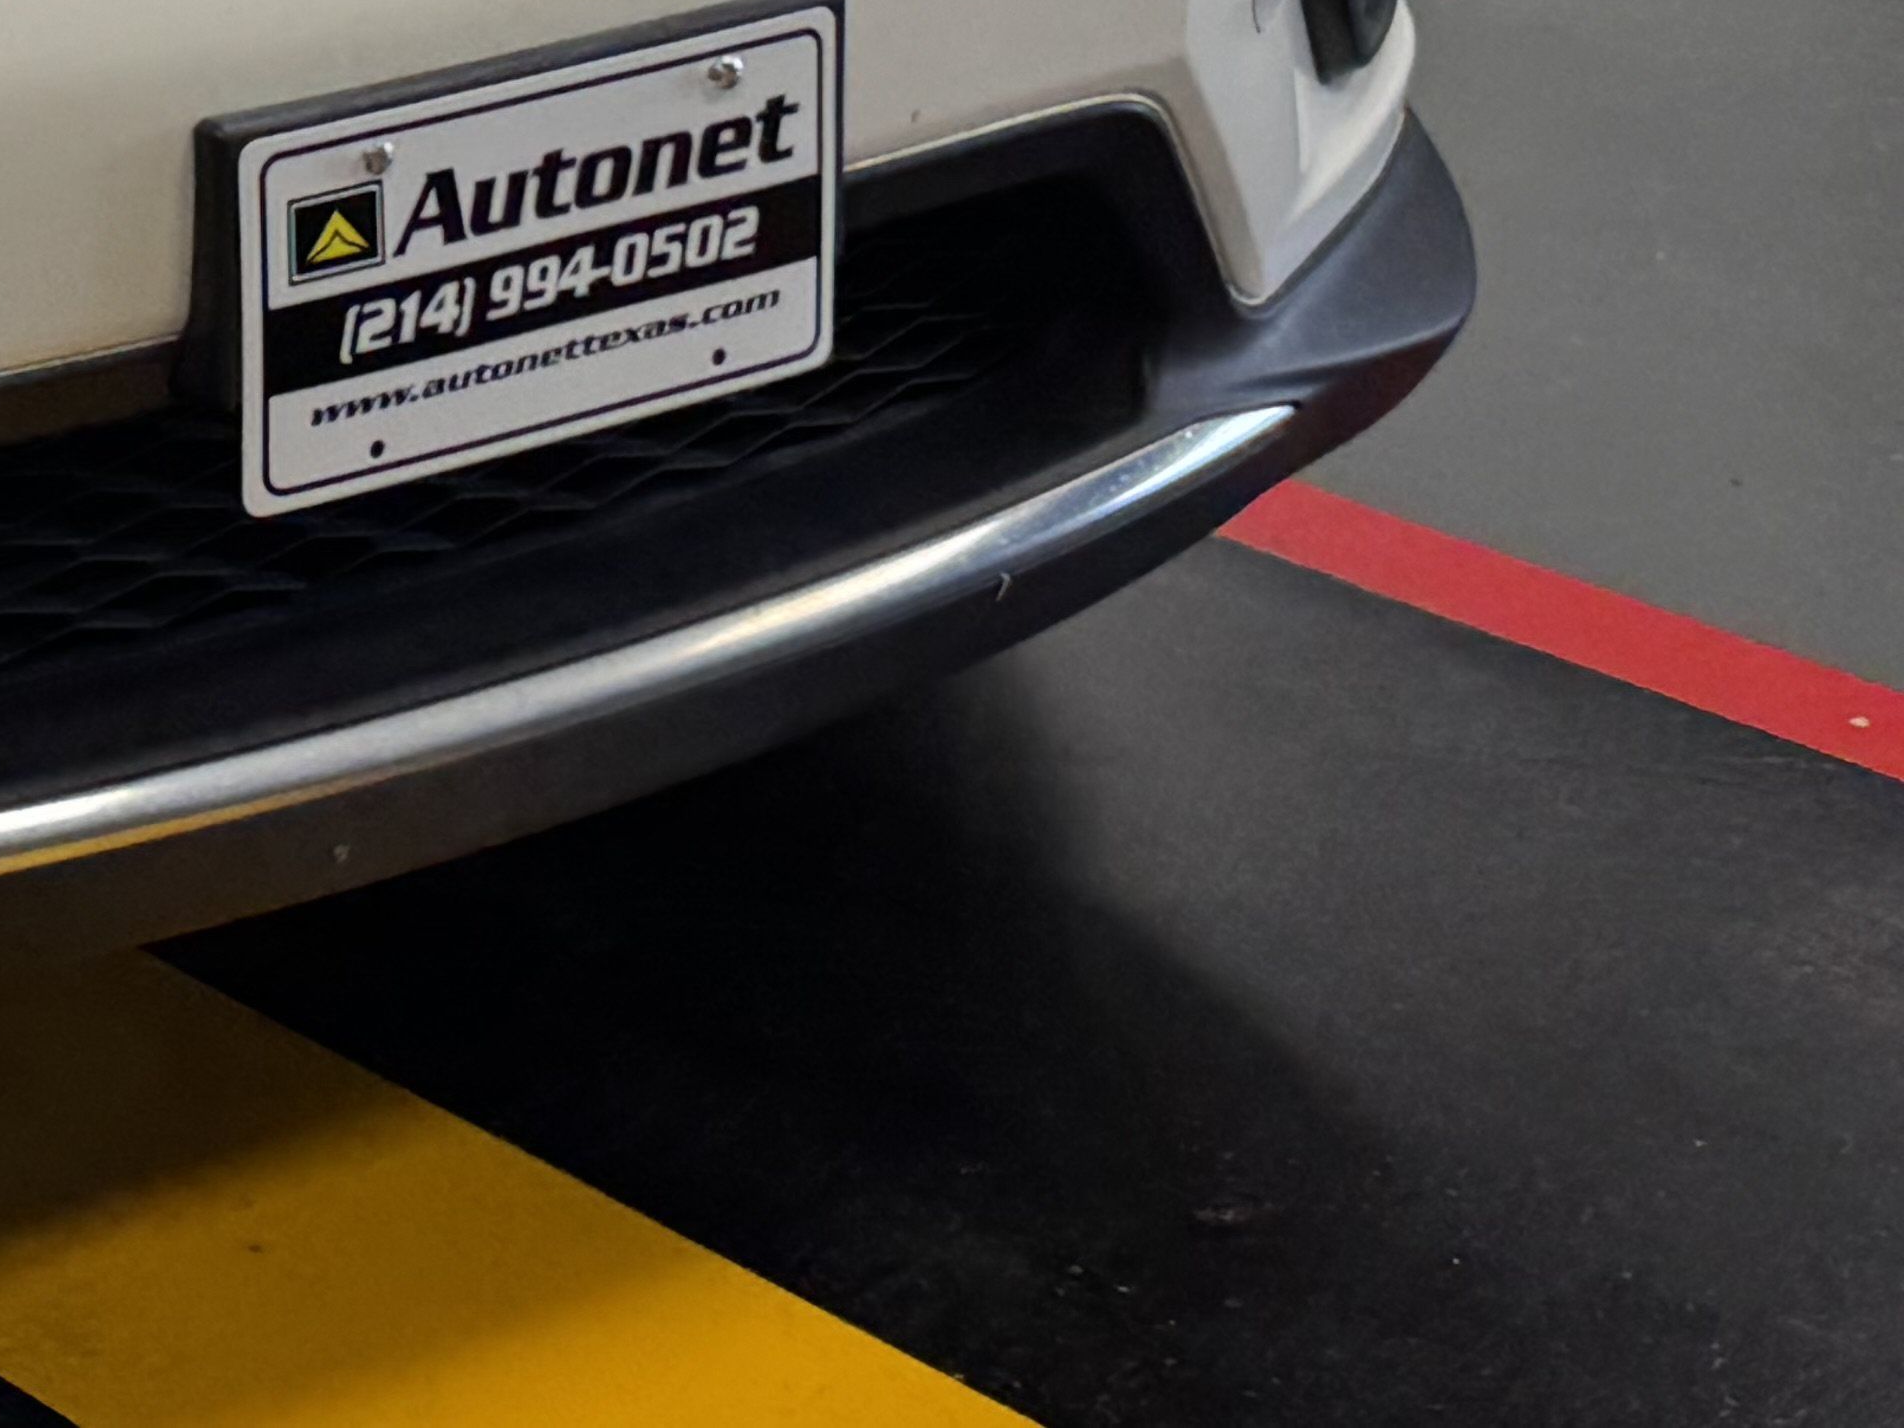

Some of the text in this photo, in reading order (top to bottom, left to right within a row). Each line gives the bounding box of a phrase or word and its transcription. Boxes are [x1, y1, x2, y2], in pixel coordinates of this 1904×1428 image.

[393, 94, 798, 256] Autonet
[310, 287, 780, 427] www.autonettexas.com
[340, 205, 759, 364] (214) 994-0502
